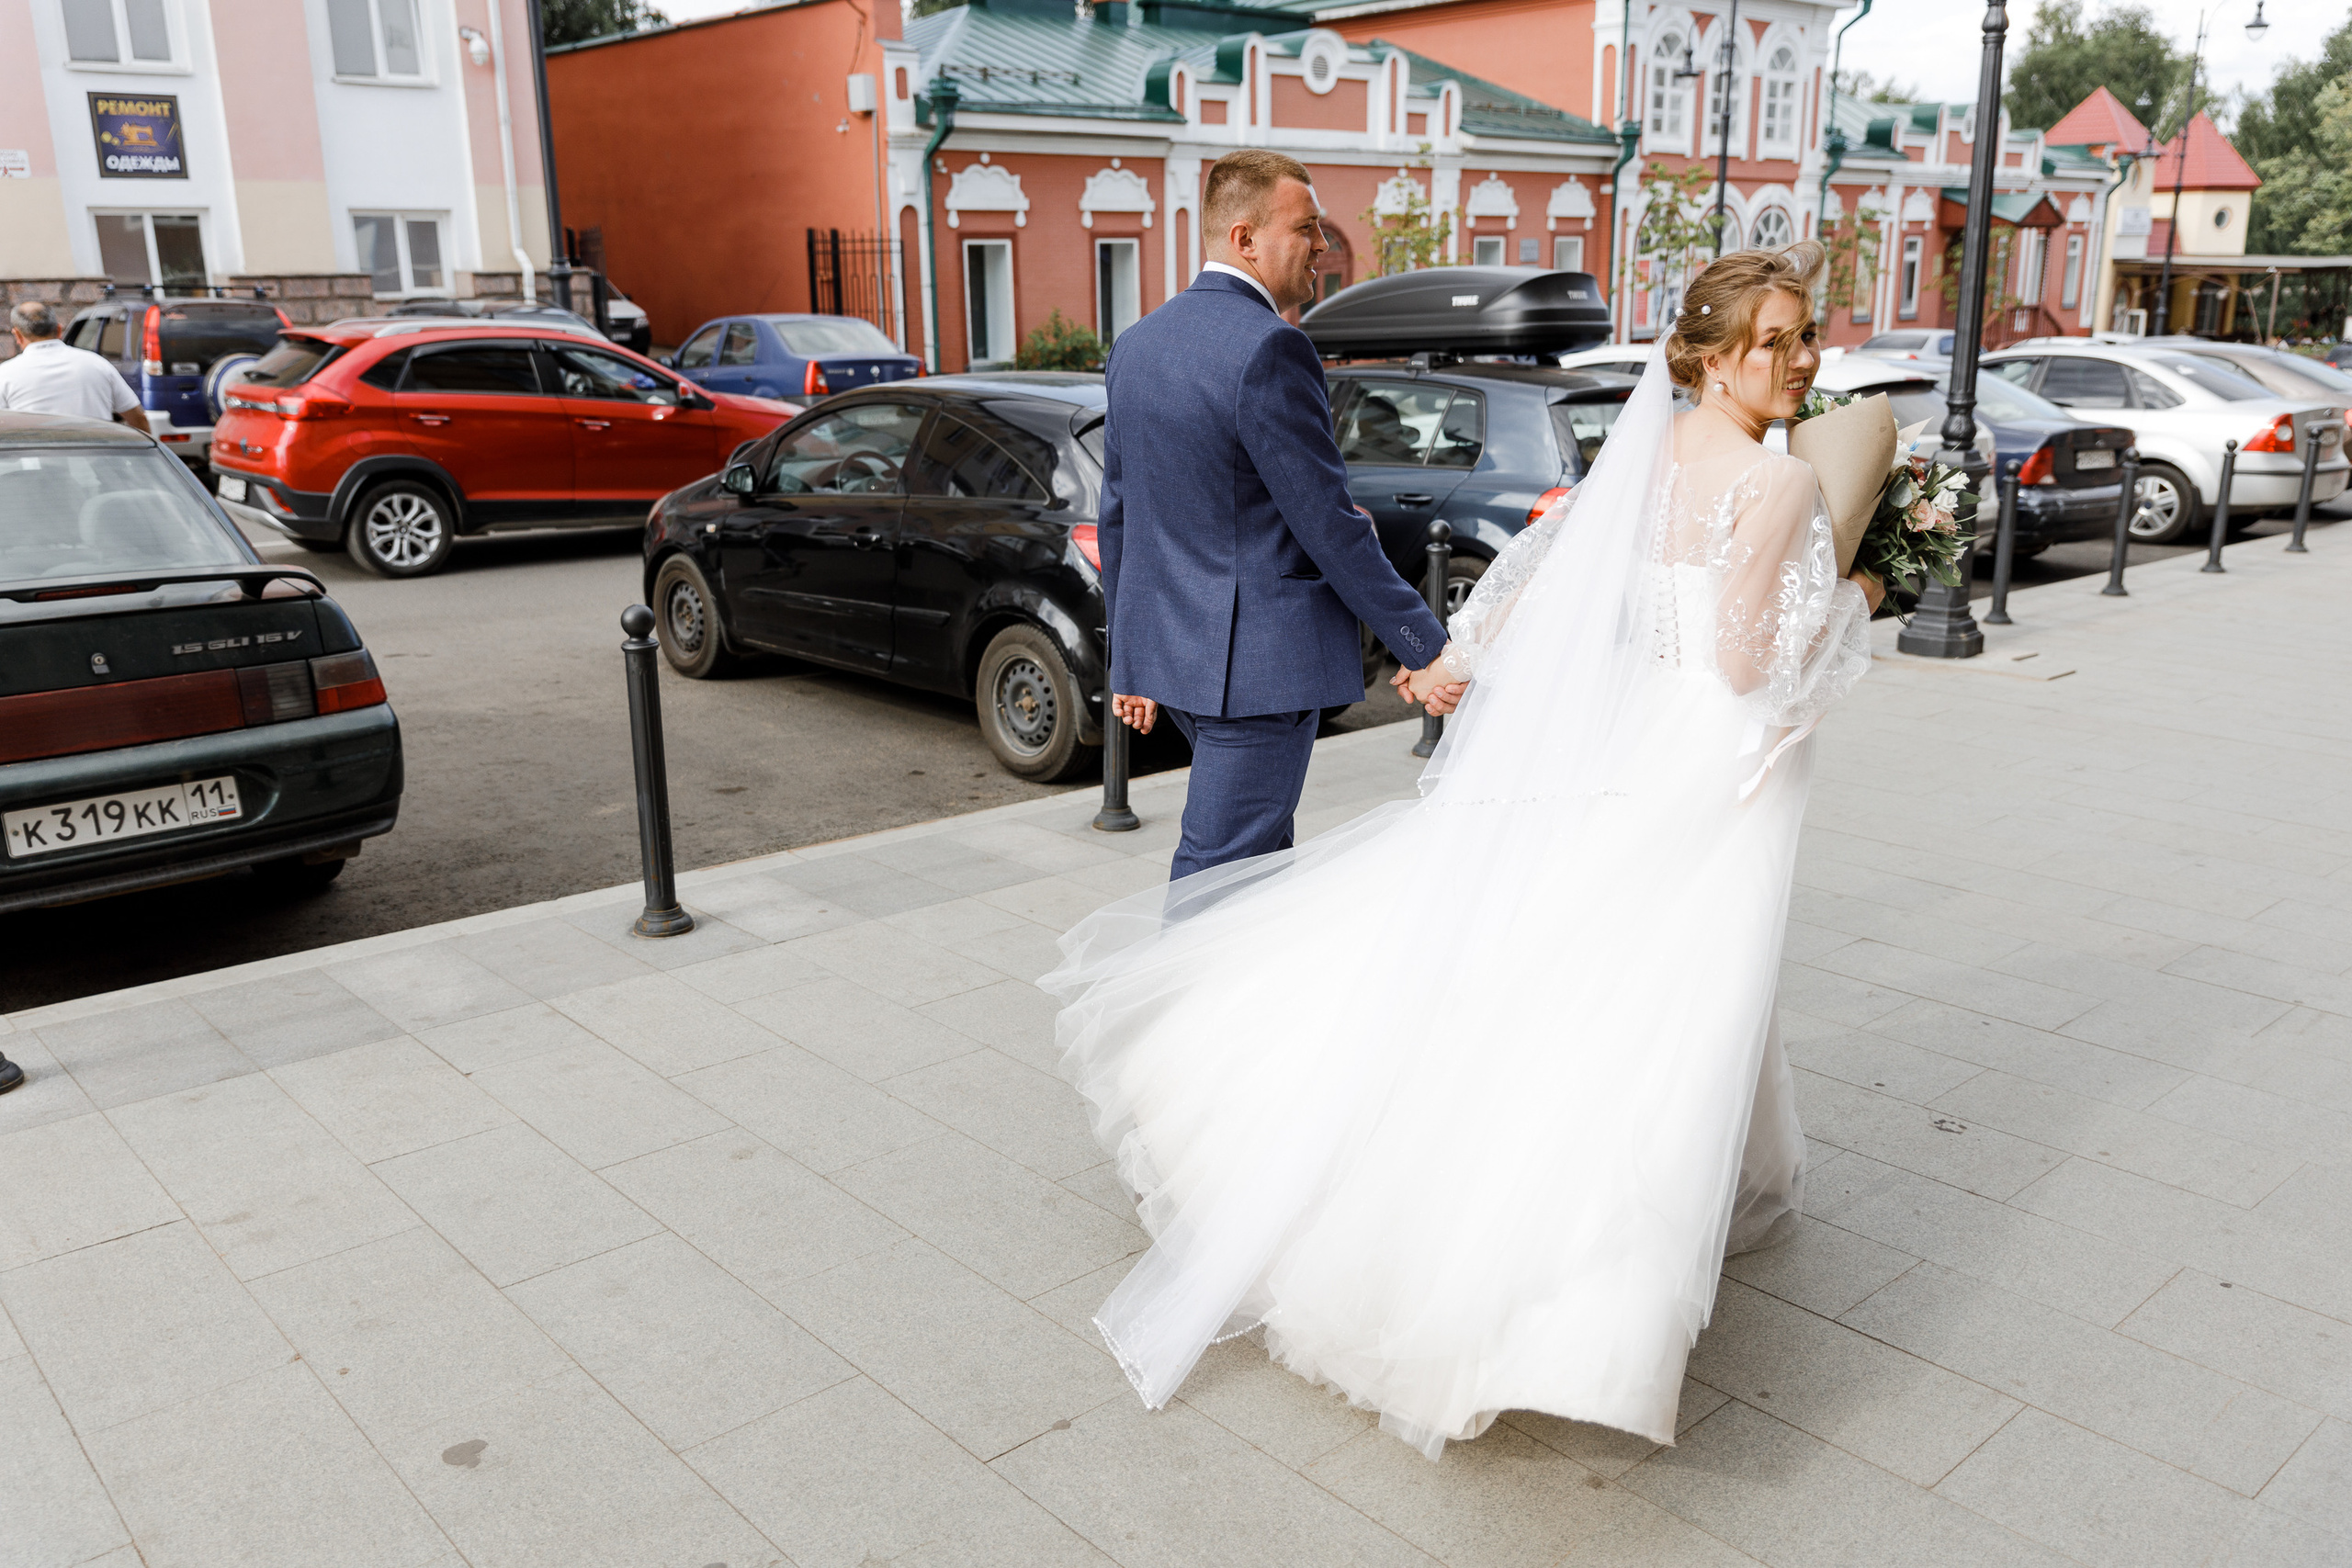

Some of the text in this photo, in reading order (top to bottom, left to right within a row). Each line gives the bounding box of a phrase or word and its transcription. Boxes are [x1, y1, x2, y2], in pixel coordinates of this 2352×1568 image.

[96, 99, 172, 118] РЕМОНТ
[106, 154, 181, 173] ОДЕЖДЫ
[190, 781, 225, 807] 11
[191, 807, 217, 820] RUS
